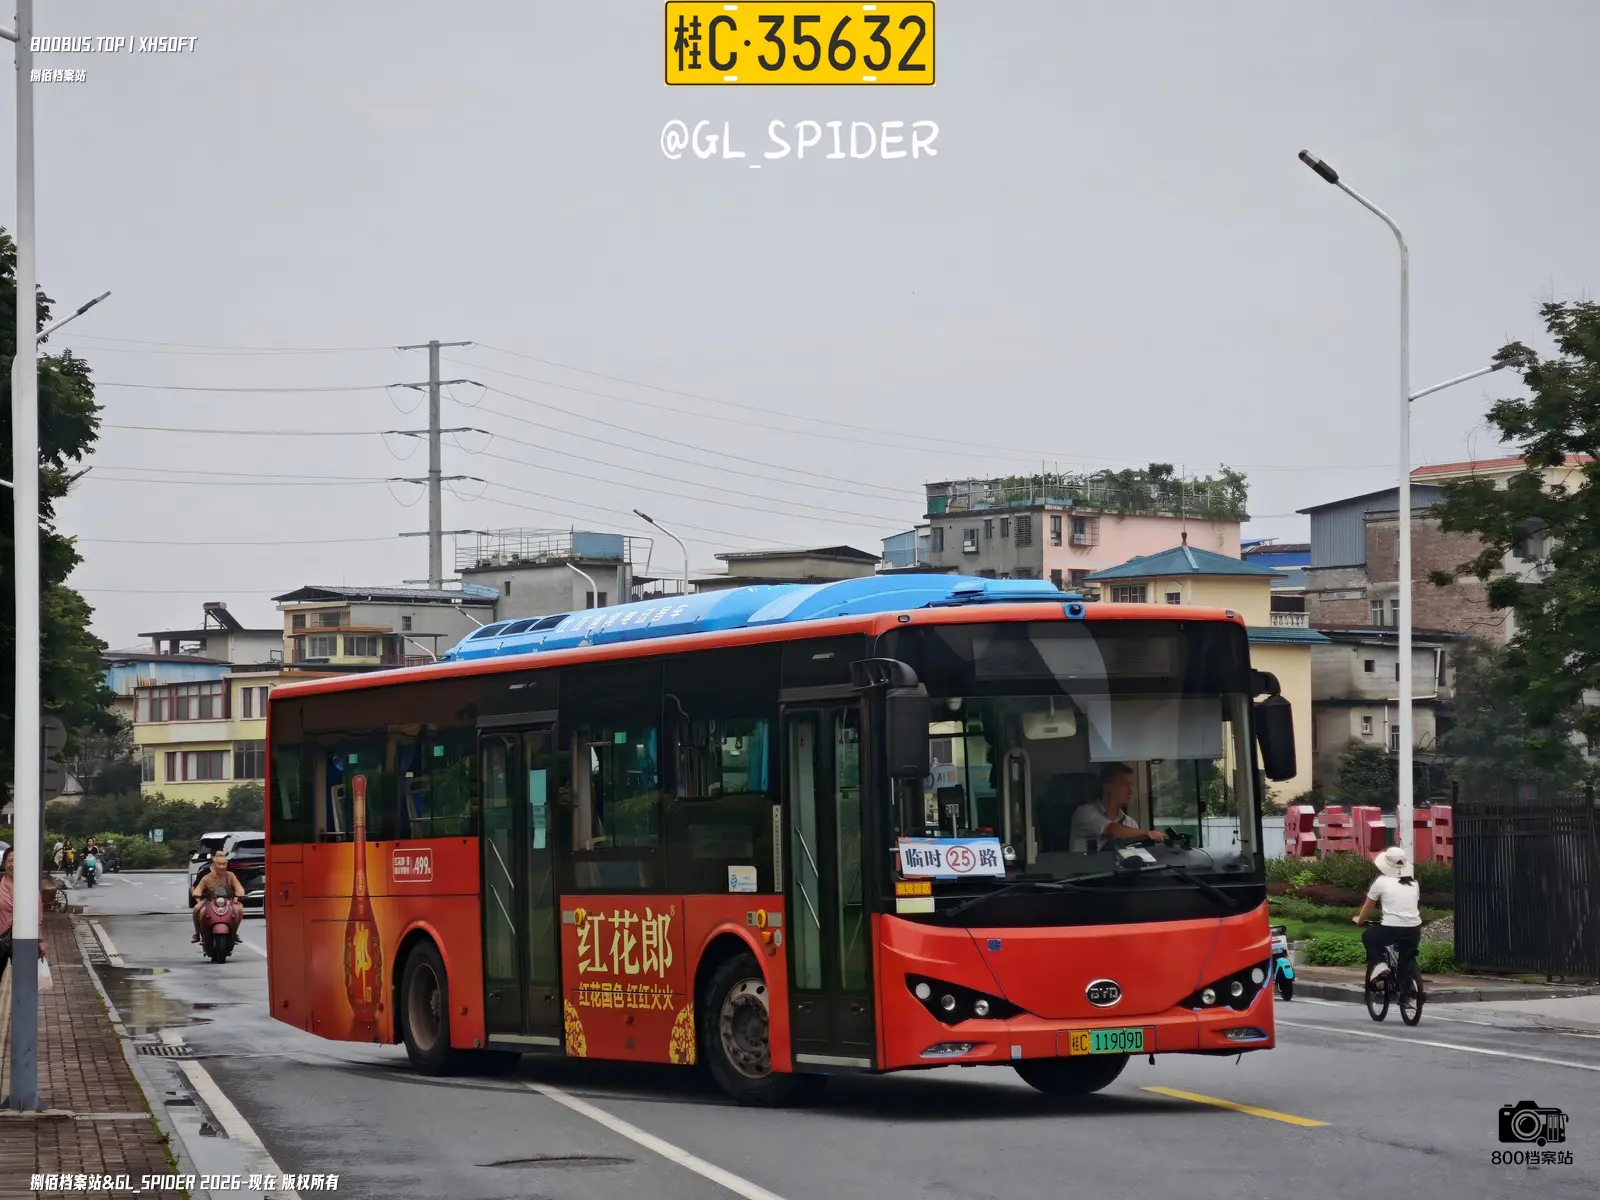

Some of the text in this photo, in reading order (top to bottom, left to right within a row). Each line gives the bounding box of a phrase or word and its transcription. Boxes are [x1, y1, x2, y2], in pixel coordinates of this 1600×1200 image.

[949, 850, 971, 868] 25
[979, 848, 998, 868] 路
[577, 907, 673, 978] 红花郎
[1090, 987, 1118, 1000] BYD
